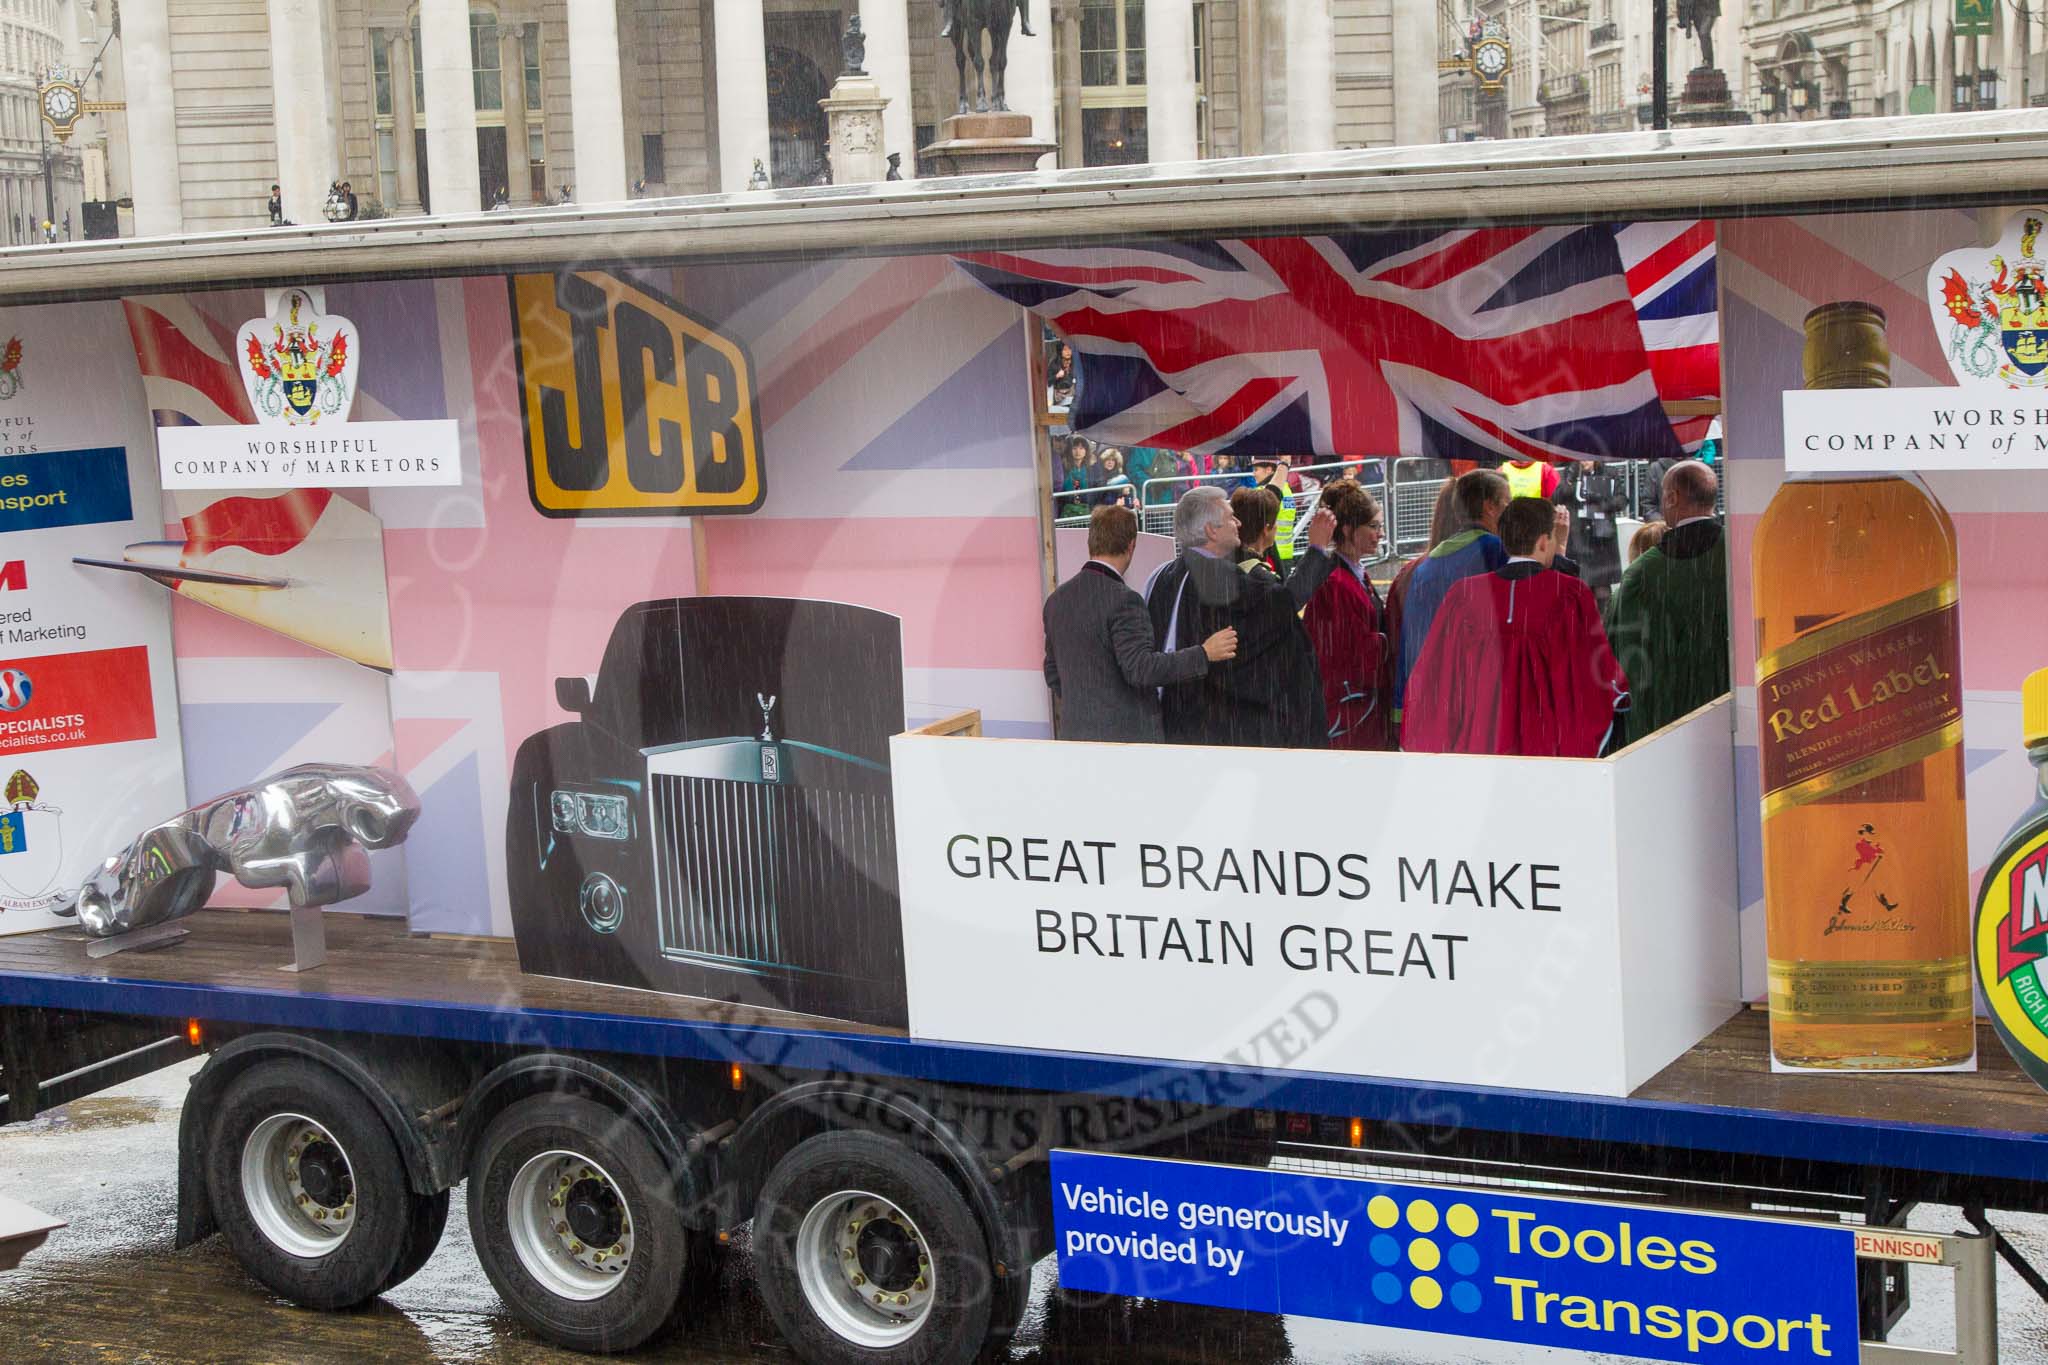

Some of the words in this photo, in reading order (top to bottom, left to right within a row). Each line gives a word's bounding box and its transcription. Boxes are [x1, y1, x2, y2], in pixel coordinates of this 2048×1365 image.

[539, 271, 747, 494] JCB
[174, 461, 271, 475] COMPANY
[282, 459, 298, 477] of
[307, 457, 442, 474] MARKETORS
[248, 439, 378, 455] WORSHIPFUL
[1804, 433, 1969, 451] COMPANY
[1992, 432, 2017, 455] of
[9, 624, 87, 644] Marketing
[0, 729, 86, 748] cialists.co.uk
[1768, 692, 1842, 743] Red
[1786, 735, 1842, 763] BLENDED
[946, 833, 1117, 886] GREAT
[1139, 843, 1372, 901] BRANDS
[1398, 856, 1562, 913] MAKE
[1034, 908, 1255, 967] BRITAIN
[1279, 924, 1469, 982] GREAT
[2015, 975, 2046, 1014] RICH
[1060, 1182, 1169, 1220] Vehicle
[1177, 1198, 1350, 1247] generously
[1065, 1229, 1198, 1266] provided
[1207, 1239, 1245, 1276] by
[1491, 1208, 1718, 1275] Tooles
[1493, 1276, 1832, 1357] Transport
